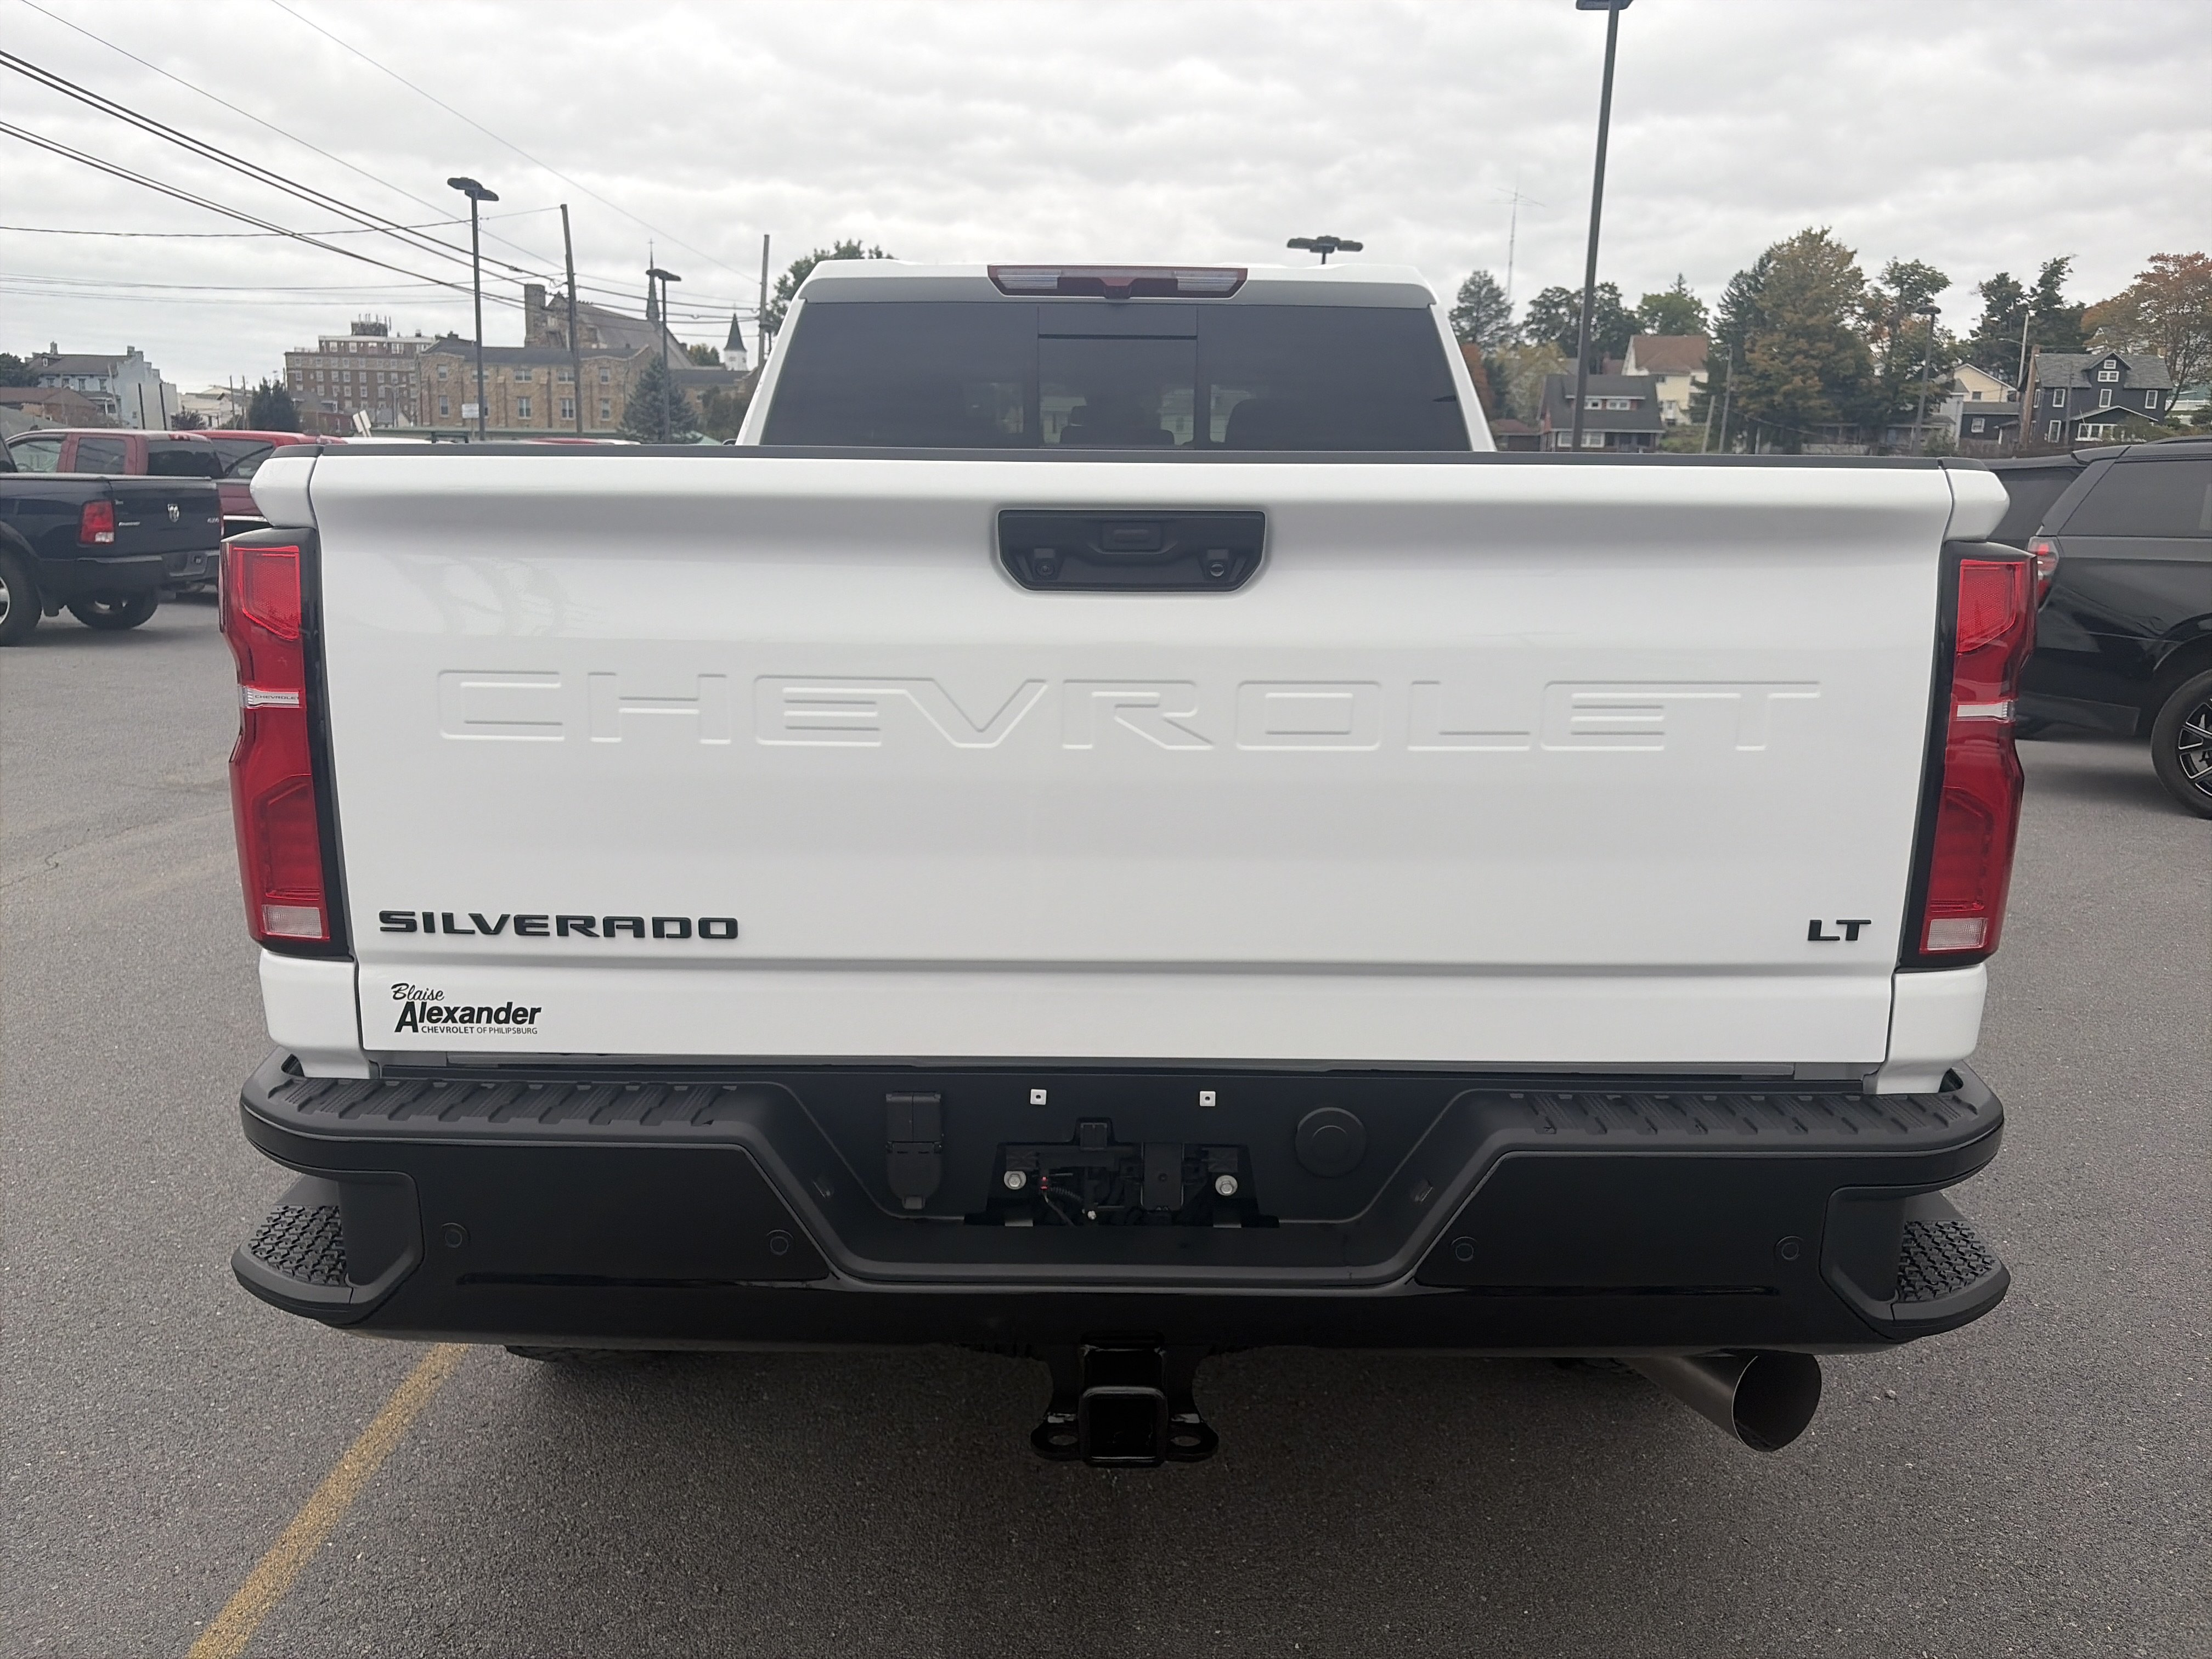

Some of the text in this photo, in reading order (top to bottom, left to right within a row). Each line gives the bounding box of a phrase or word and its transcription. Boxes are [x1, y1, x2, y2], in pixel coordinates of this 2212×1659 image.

[437, 669, 1821, 752] CHEVROLET
[379, 910, 738, 940] SILVERADO
[1807, 919, 1872, 941] LT
[391, 983, 445, 1001] Blaise
[394, 1001, 542, 1033] Alexander
[421, 1025, 475, 1034] CHEVROLET
[489, 1026, 538, 1035] PHILIPSBURG
